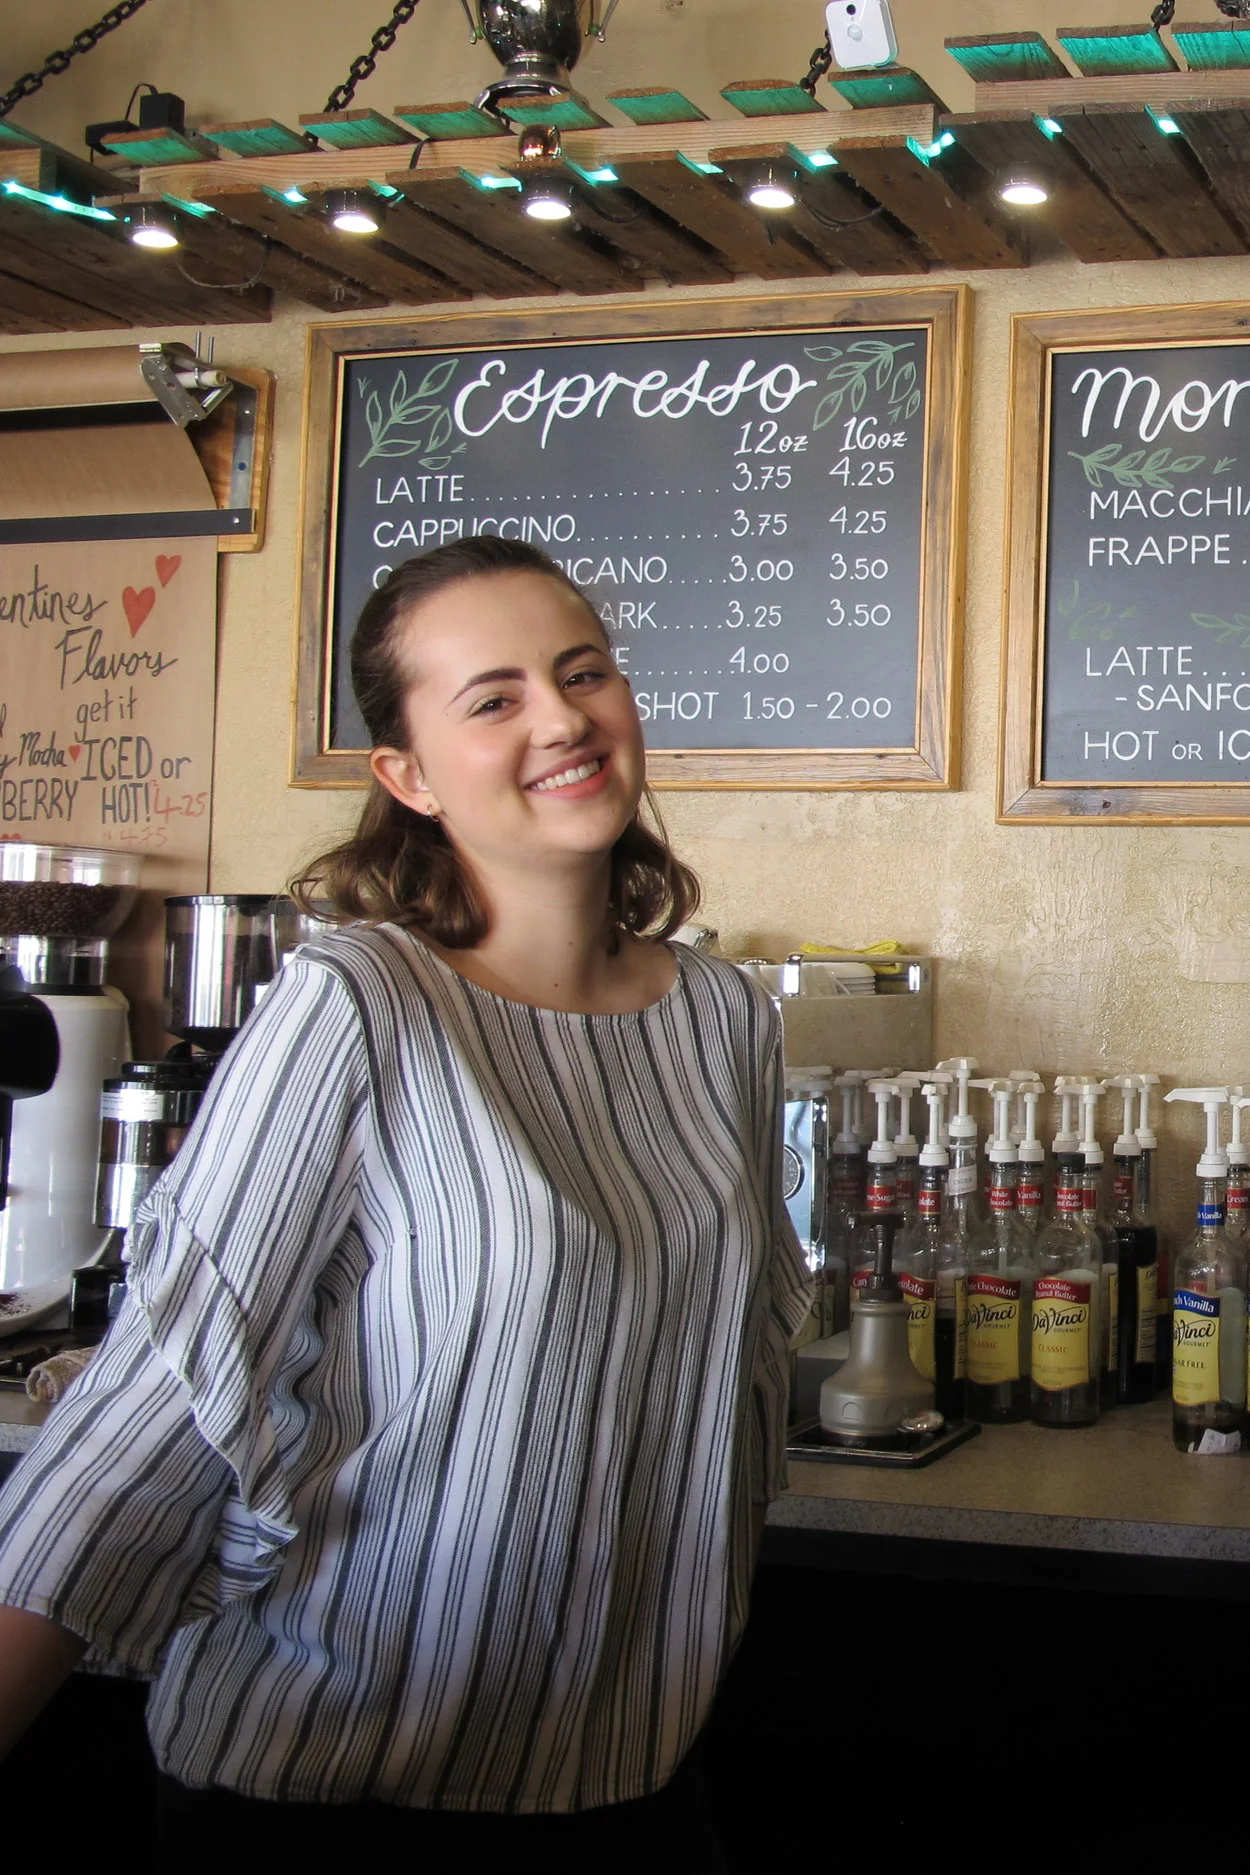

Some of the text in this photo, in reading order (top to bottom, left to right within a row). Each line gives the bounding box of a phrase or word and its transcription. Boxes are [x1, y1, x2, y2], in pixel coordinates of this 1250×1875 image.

[454, 359, 817, 450] Espresso
[734, 416, 908, 456] 12oz 16oz
[375, 456, 896, 505] LATTE 3.75 4.25
[373, 505, 888, 548] CAPPUCCINO 3.75 4.25
[1088, 533, 1231, 567] FRAPPE
[728, 555, 794, 583] 3.00
[829, 553, 889, 581] 3.50
[725, 600, 782, 629] 3.25
[826, 598, 891, 628] 3.50
[55, 626, 178, 690] Flavors
[729, 645, 790, 675] 4.00
[1086, 646, 1193, 677] LATTE
[75, 686, 137, 742] get it
[636, 691, 720, 721] SHOT
[742, 691, 796, 720] 1.50
[826, 691, 892, 720] 2.00
[19, 731, 67, 767] Mocha
[81, 736, 191, 781] ICED or
[1084, 730, 1159, 761] HOT
[2, 778, 78, 821] BERRY
[101, 783, 151, 824] HOT!
[977, 1281, 1017, 1297] Chocolate
[1038, 1282, 1072, 1291] Chocolate
[1055, 1290, 1077, 1301] Butter
[1183, 1296, 1215, 1313] Vanilla
